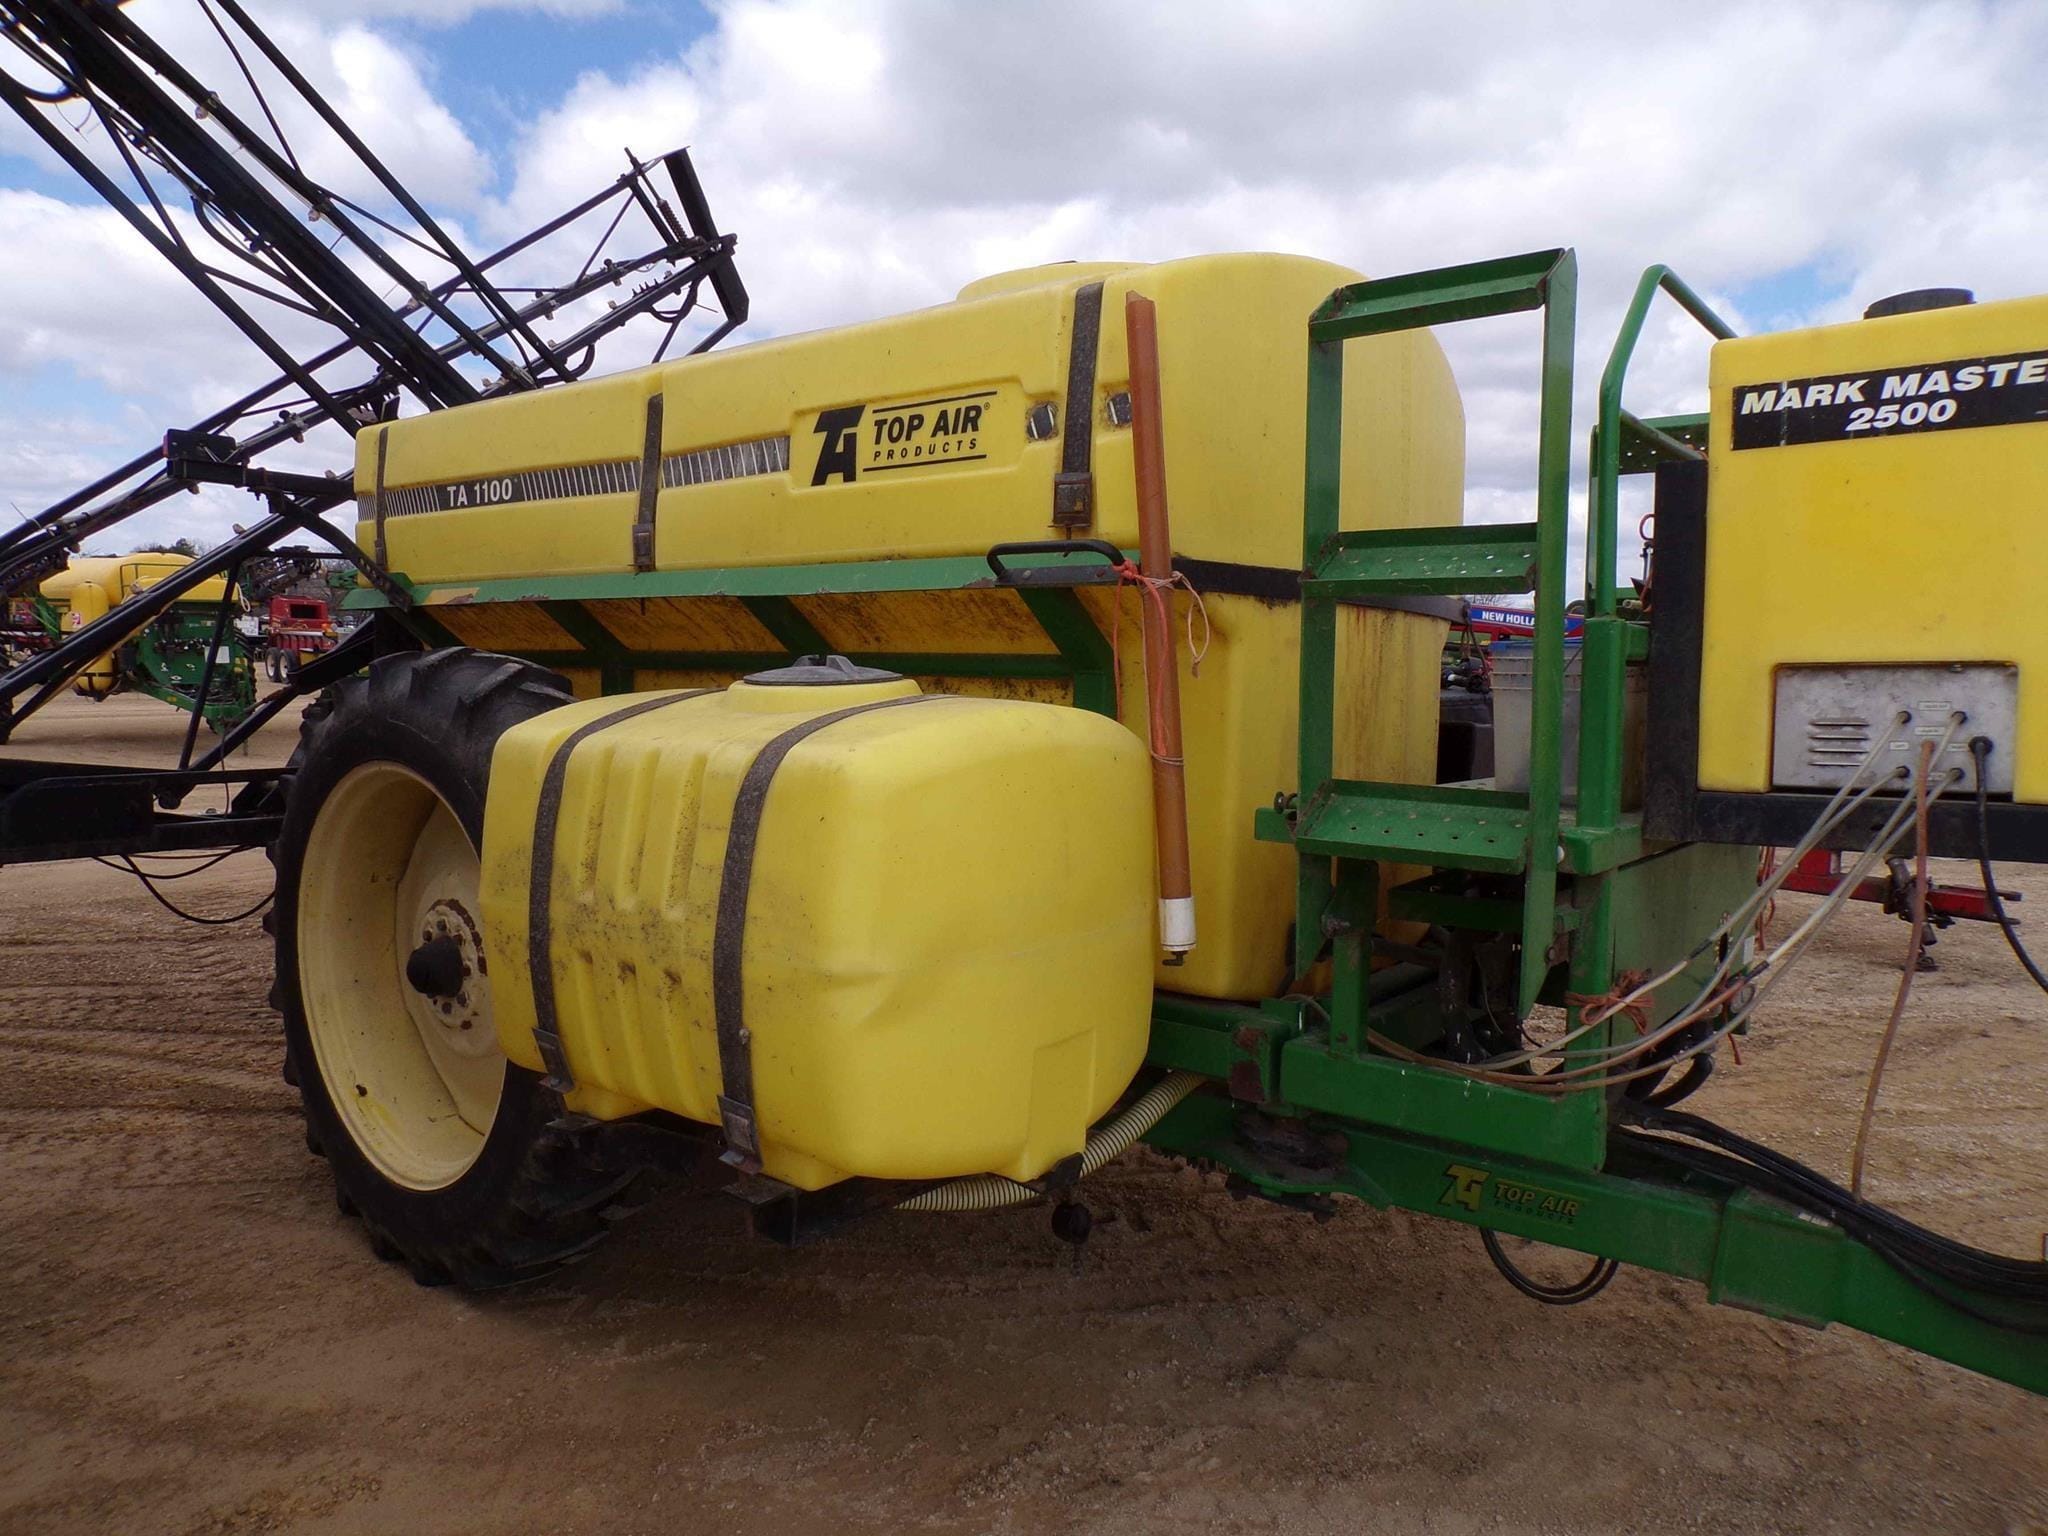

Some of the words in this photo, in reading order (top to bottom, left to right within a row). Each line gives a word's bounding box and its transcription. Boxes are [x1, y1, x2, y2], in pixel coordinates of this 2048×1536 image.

[1740, 379, 1870, 415] MARK
[1880, 358, 2048, 400] MASTE
[873, 413, 925, 446] TOP
[930, 404, 983, 438] AIR
[1845, 399, 1958, 433] 2500
[873, 437, 978, 462] PRODUCTS
[447, 484, 468, 507] TA
[473, 478, 513, 504] 1100
[1482, 611, 1504, 621] NEW
[1495, 1183, 1536, 1204] TOP
[1541, 1196, 1579, 1216] AIR
